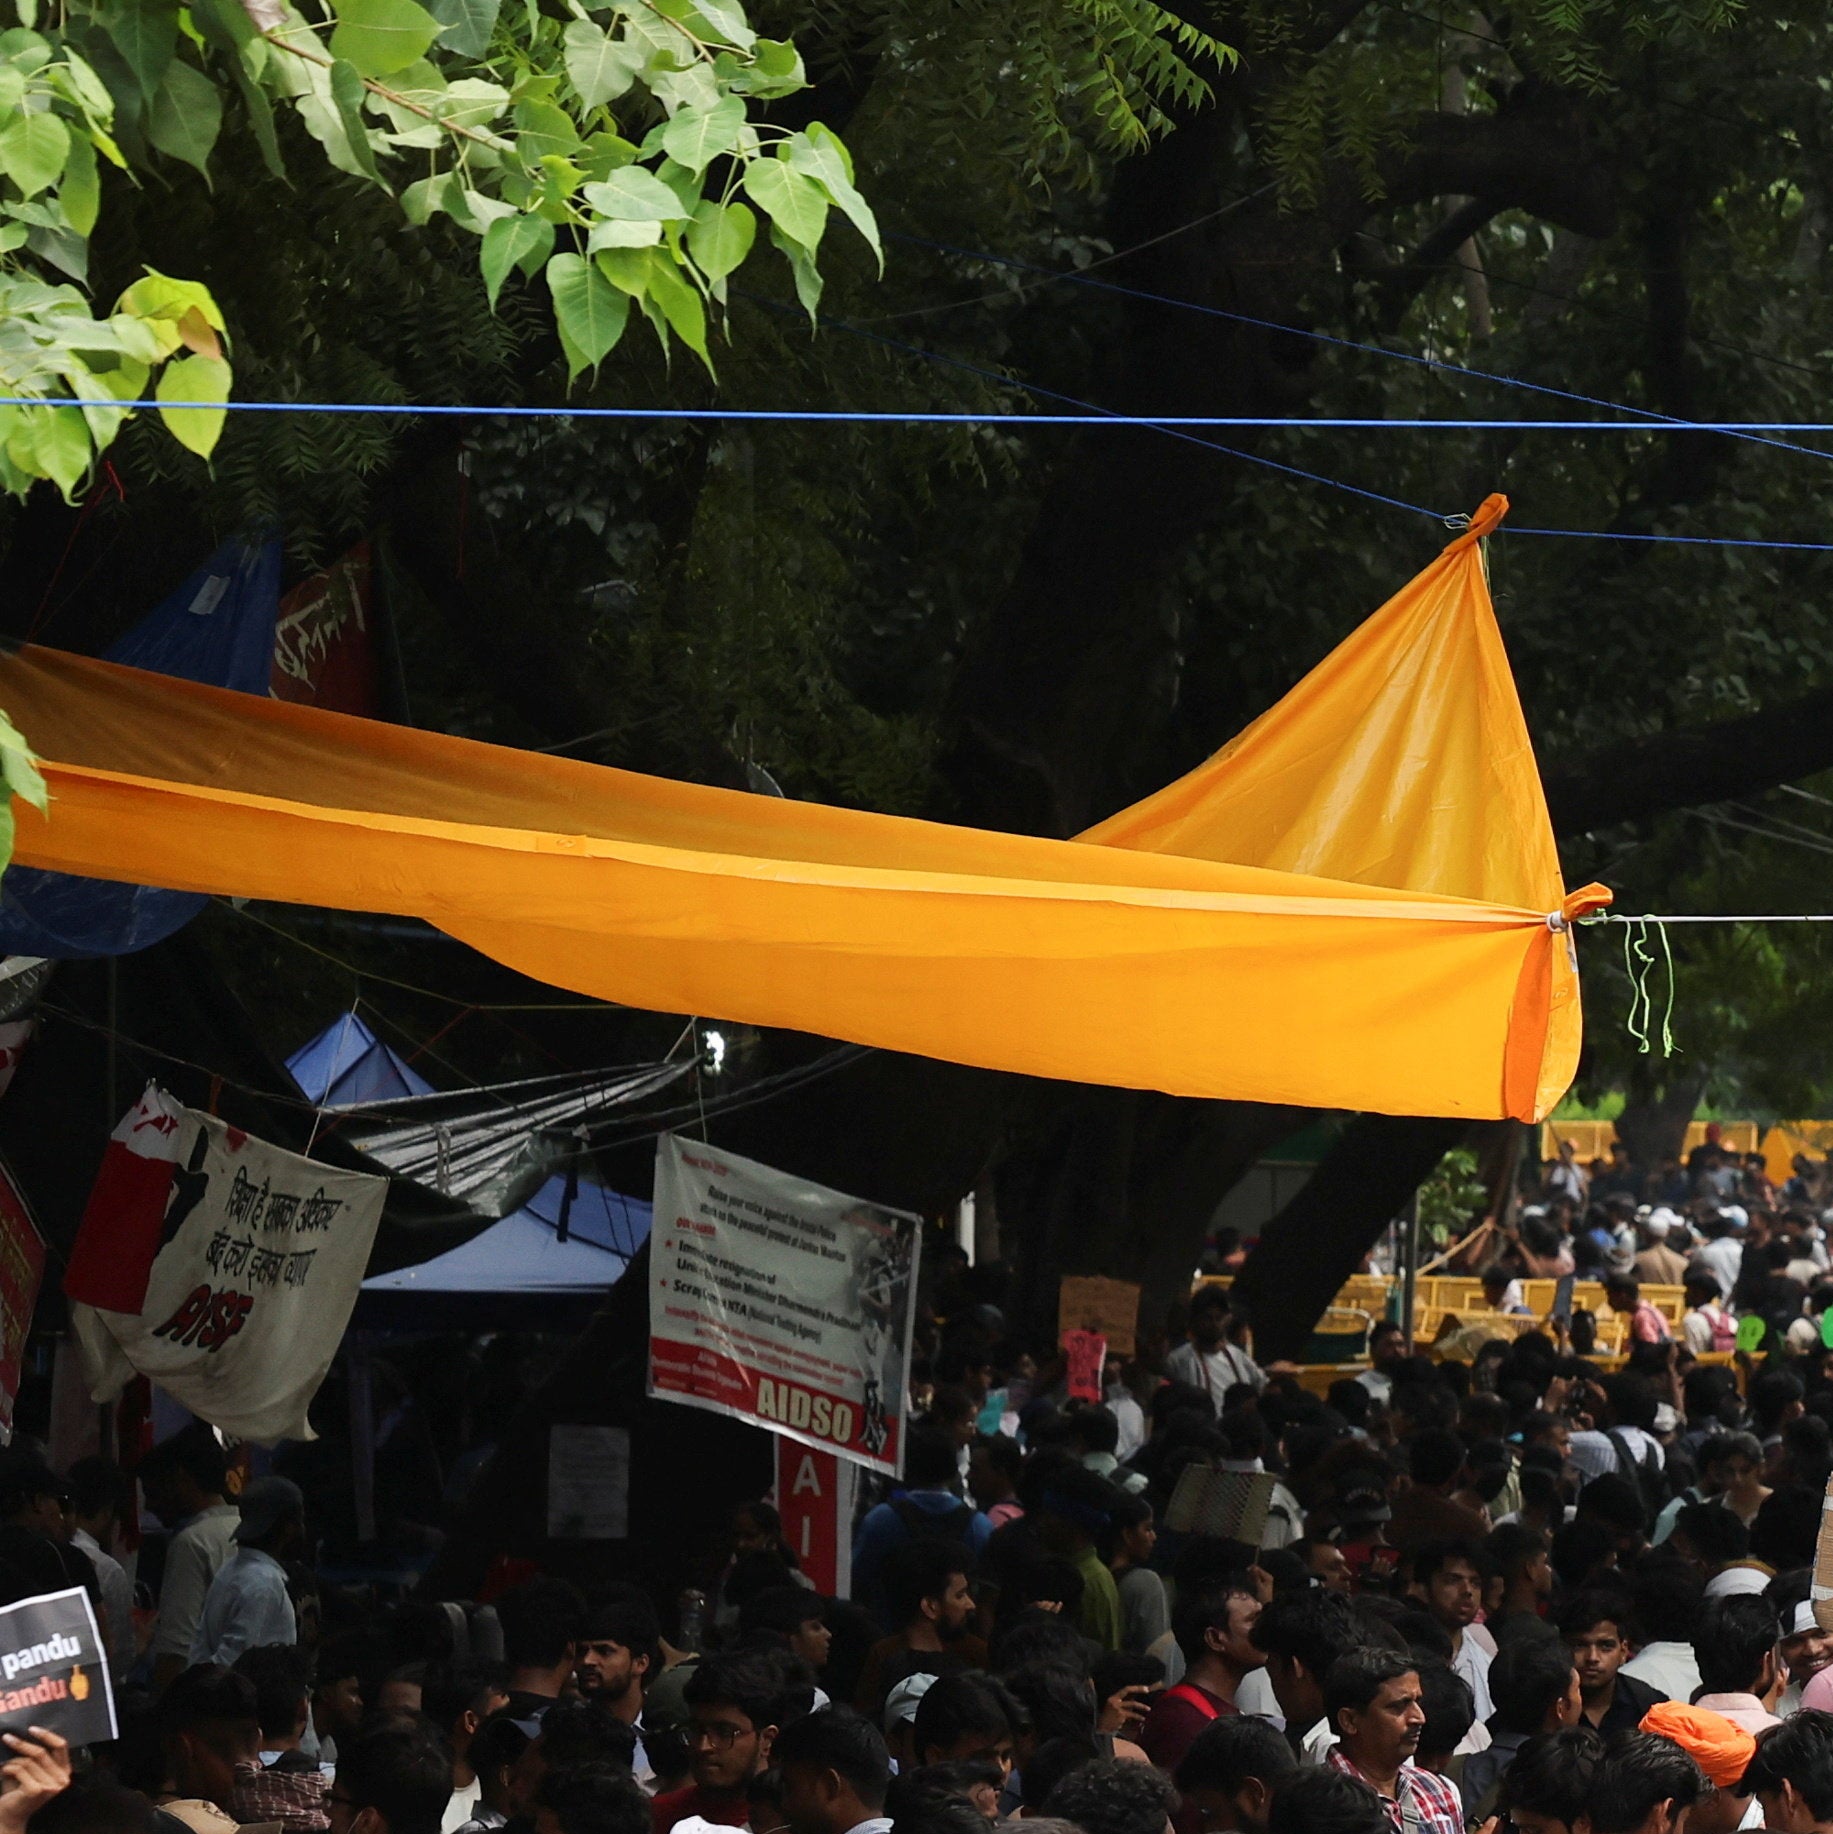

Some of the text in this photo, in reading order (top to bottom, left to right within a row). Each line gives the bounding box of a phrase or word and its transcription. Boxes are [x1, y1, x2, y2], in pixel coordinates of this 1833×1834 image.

[152, 1284, 254, 1353] AISF
[757, 1377, 853, 1444] AIDSO
[1, 1632, 81, 1680] pandu
